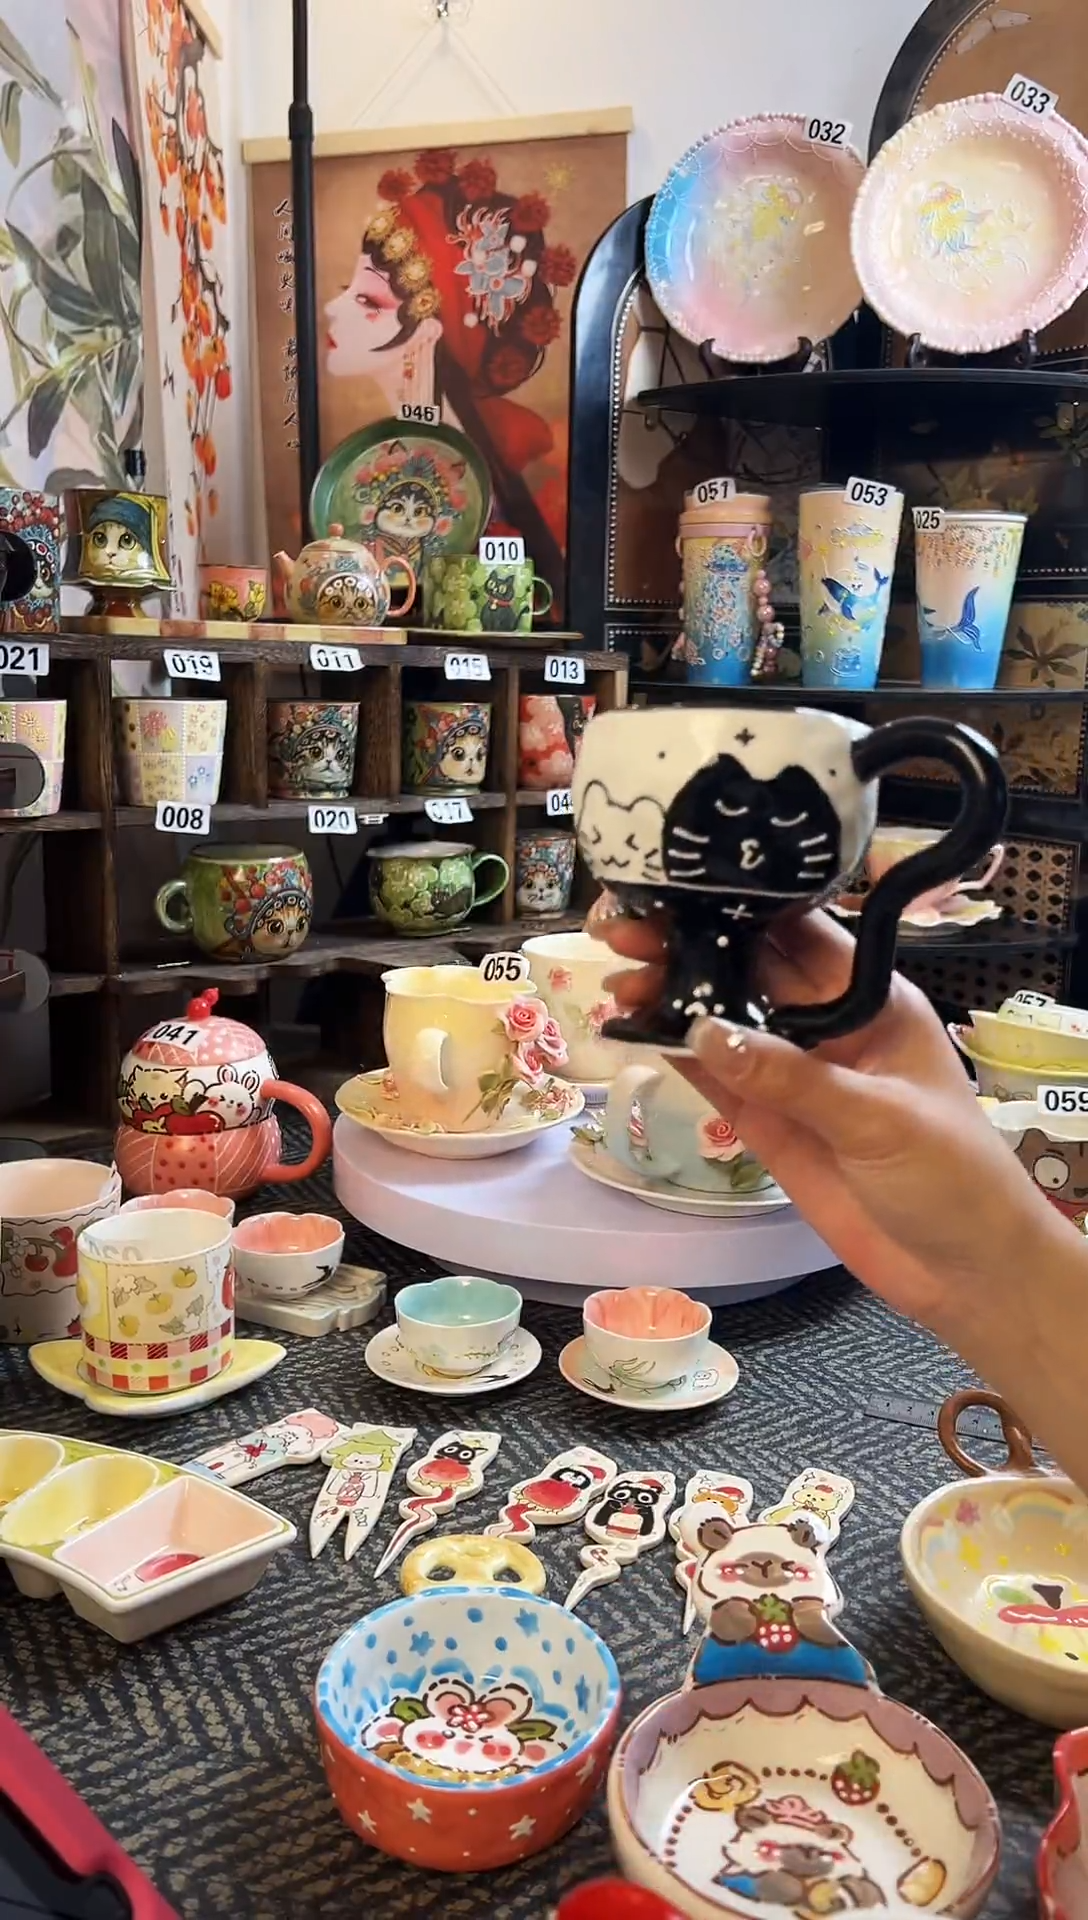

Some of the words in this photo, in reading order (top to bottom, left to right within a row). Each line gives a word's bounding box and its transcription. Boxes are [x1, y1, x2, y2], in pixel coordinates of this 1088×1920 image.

[1010, 81, 1051, 114] 033
[808, 119, 846, 144] 032
[697, 481, 729, 503] 051
[851, 482, 888, 506] 053
[916, 510, 940, 529] 025
[485, 541, 519, 561] 010
[550, 658, 579, 680] 013
[551, 793, 573, 811] 04
[162, 806, 204, 829] 008
[314, 810, 350, 829] 020
[484, 957, 522, 981] 055
[153, 1024, 200, 1045] 041
